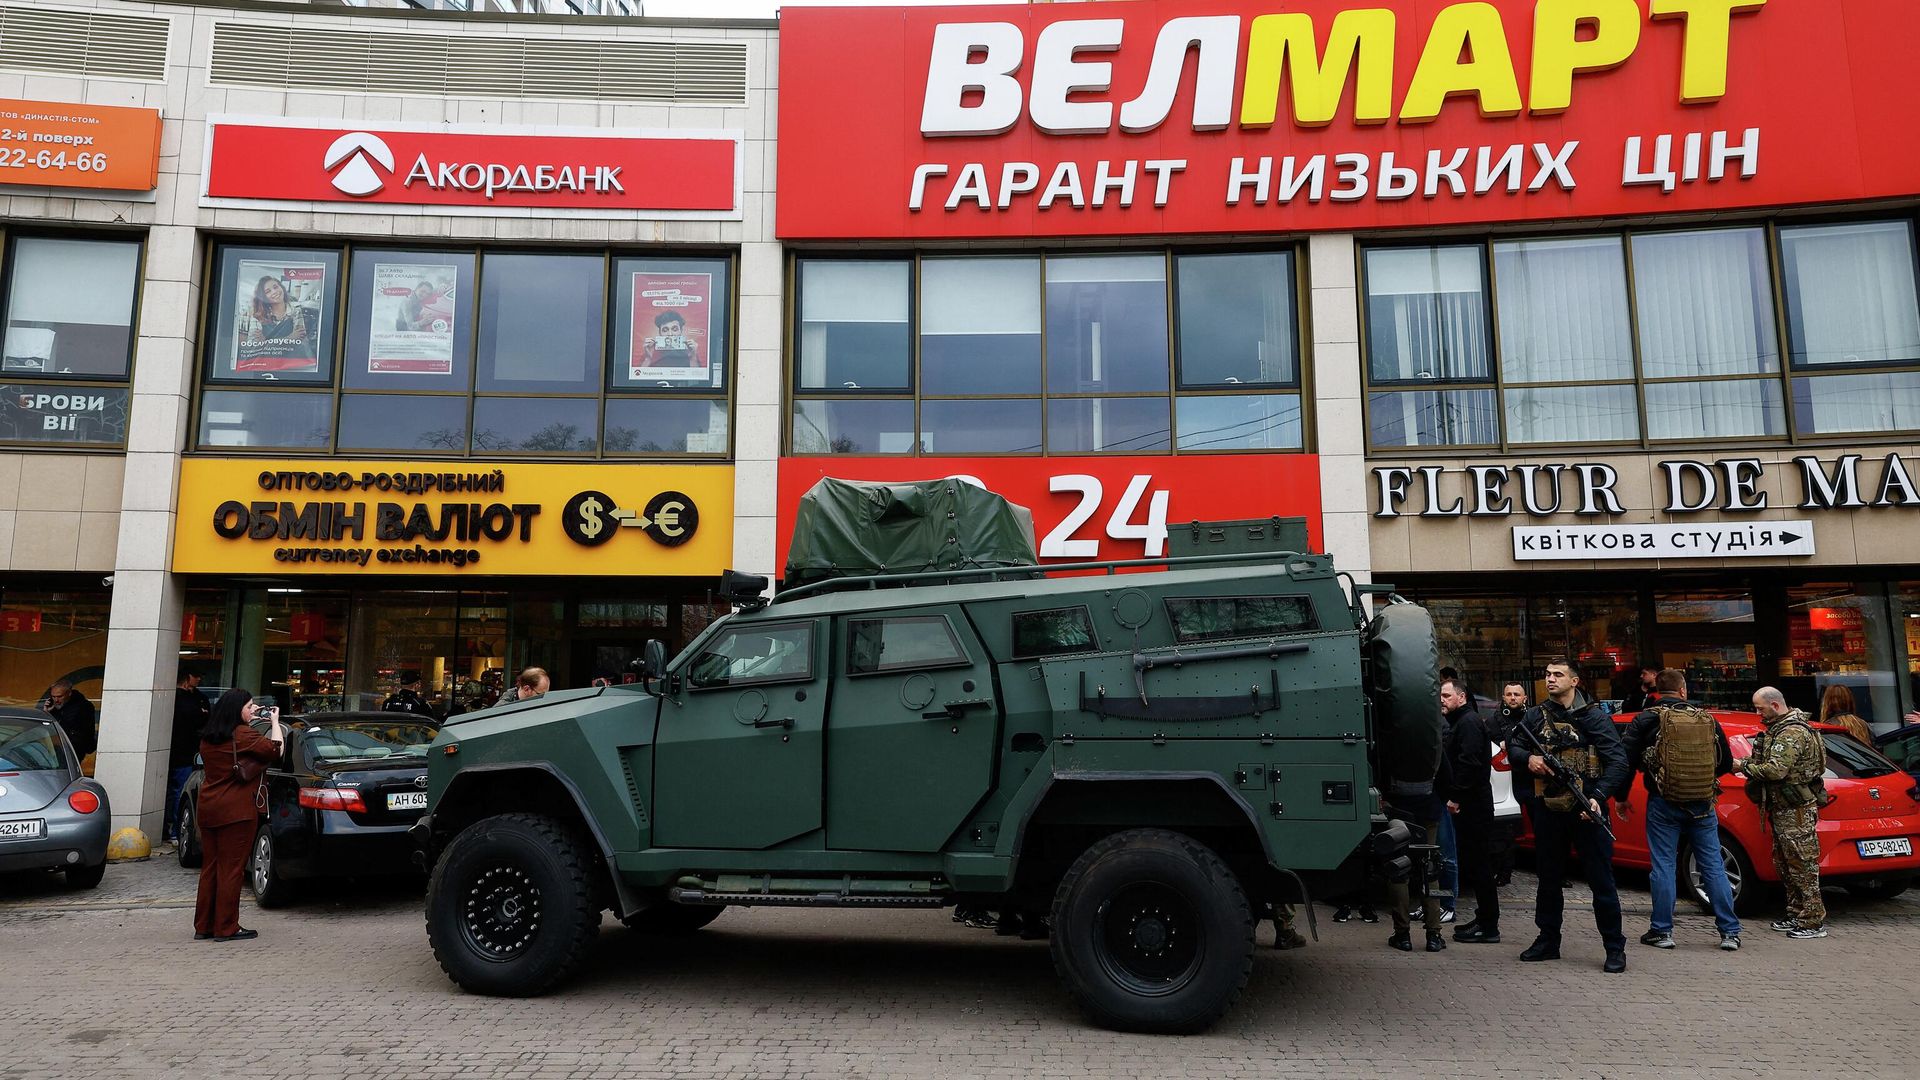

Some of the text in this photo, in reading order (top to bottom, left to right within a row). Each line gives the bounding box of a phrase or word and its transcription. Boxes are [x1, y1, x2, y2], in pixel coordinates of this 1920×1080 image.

[919, 0, 1767, 137] ВЕЛМАРТ
[1, 111, 18, 119] ТОВ
[1, 128, 94, 147] 2-й поверх
[0, 147, 108, 172] 22-64-66
[908, 127, 1760, 212] ГАРАНТ НИЗЬКИХ ЦІН
[19, 394, 105, 411] БРОВИ
[43, 413, 78, 431] ВІЇ
[257, 469, 505, 495] ОПТОВО-РОЗДРІБНИЙ
[1371, 452, 1920, 519] FLEUR DE MA
[212, 500, 541, 543] ОБМІН ВАЛЮТ
[1040, 474, 1169, 558] 24
[273, 544, 481, 568] currency exchange
[394, 794, 409, 806] AH
[1863, 842, 1876, 854] AP
